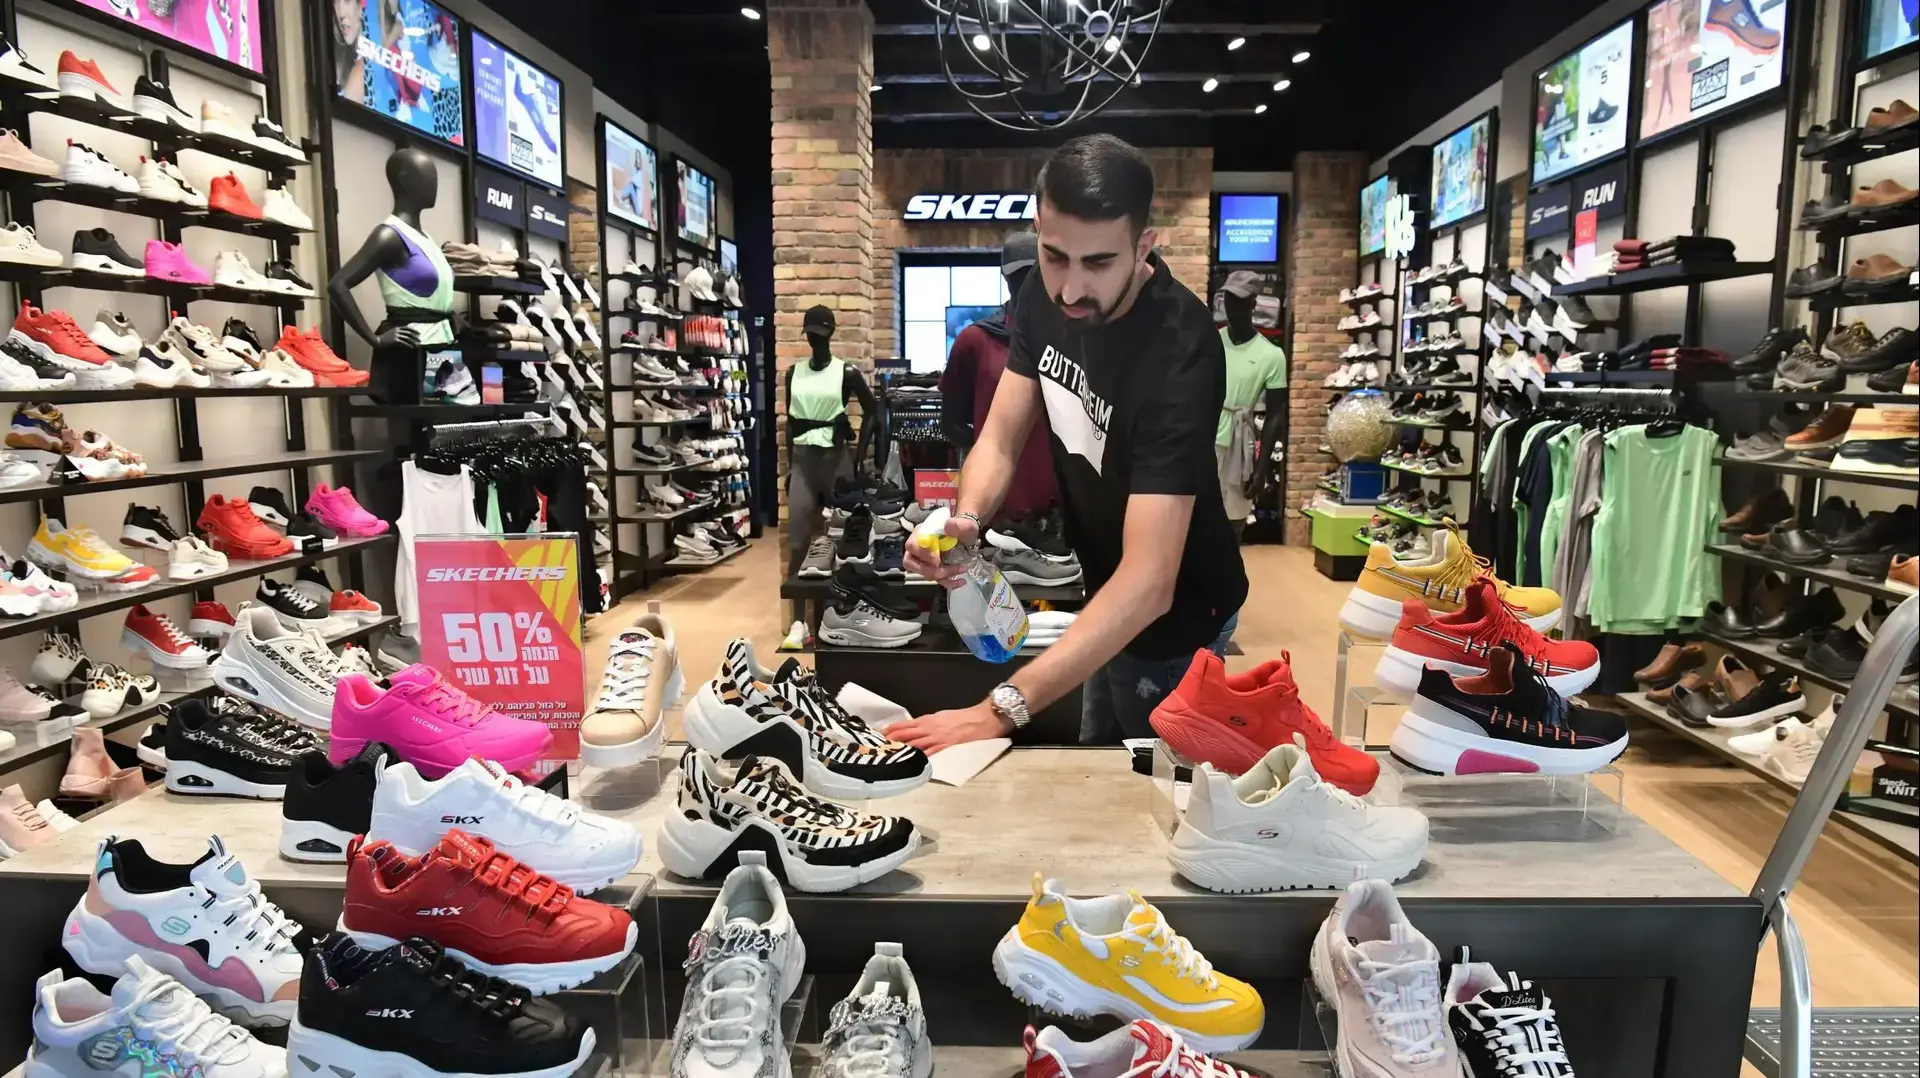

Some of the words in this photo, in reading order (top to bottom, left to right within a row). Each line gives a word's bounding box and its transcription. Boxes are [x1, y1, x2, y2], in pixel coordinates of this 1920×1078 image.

[356, 35, 441, 93] SKECHERS
[487, 187, 513, 210] RUN
[1582, 181, 1617, 210] RUN
[426, 566, 567, 582] SKECHERS
[442, 611, 552, 663] 50%
[521, 646, 560, 661] הנחה
[455, 667, 491, 686] שני
[494, 667, 520, 686] זוג
[522, 663, 550, 685] על
[537, 701, 554, 709] הזול
[556, 701, 567, 709] על
[411, 715, 443, 733] SKECHERS
[539, 712, 550, 720] על
[1885, 785, 1918, 797] KNIT
[440, 815, 484, 824] SKX
[416, 907, 464, 916] SKX
[365, 1008, 415, 1019] SKX
